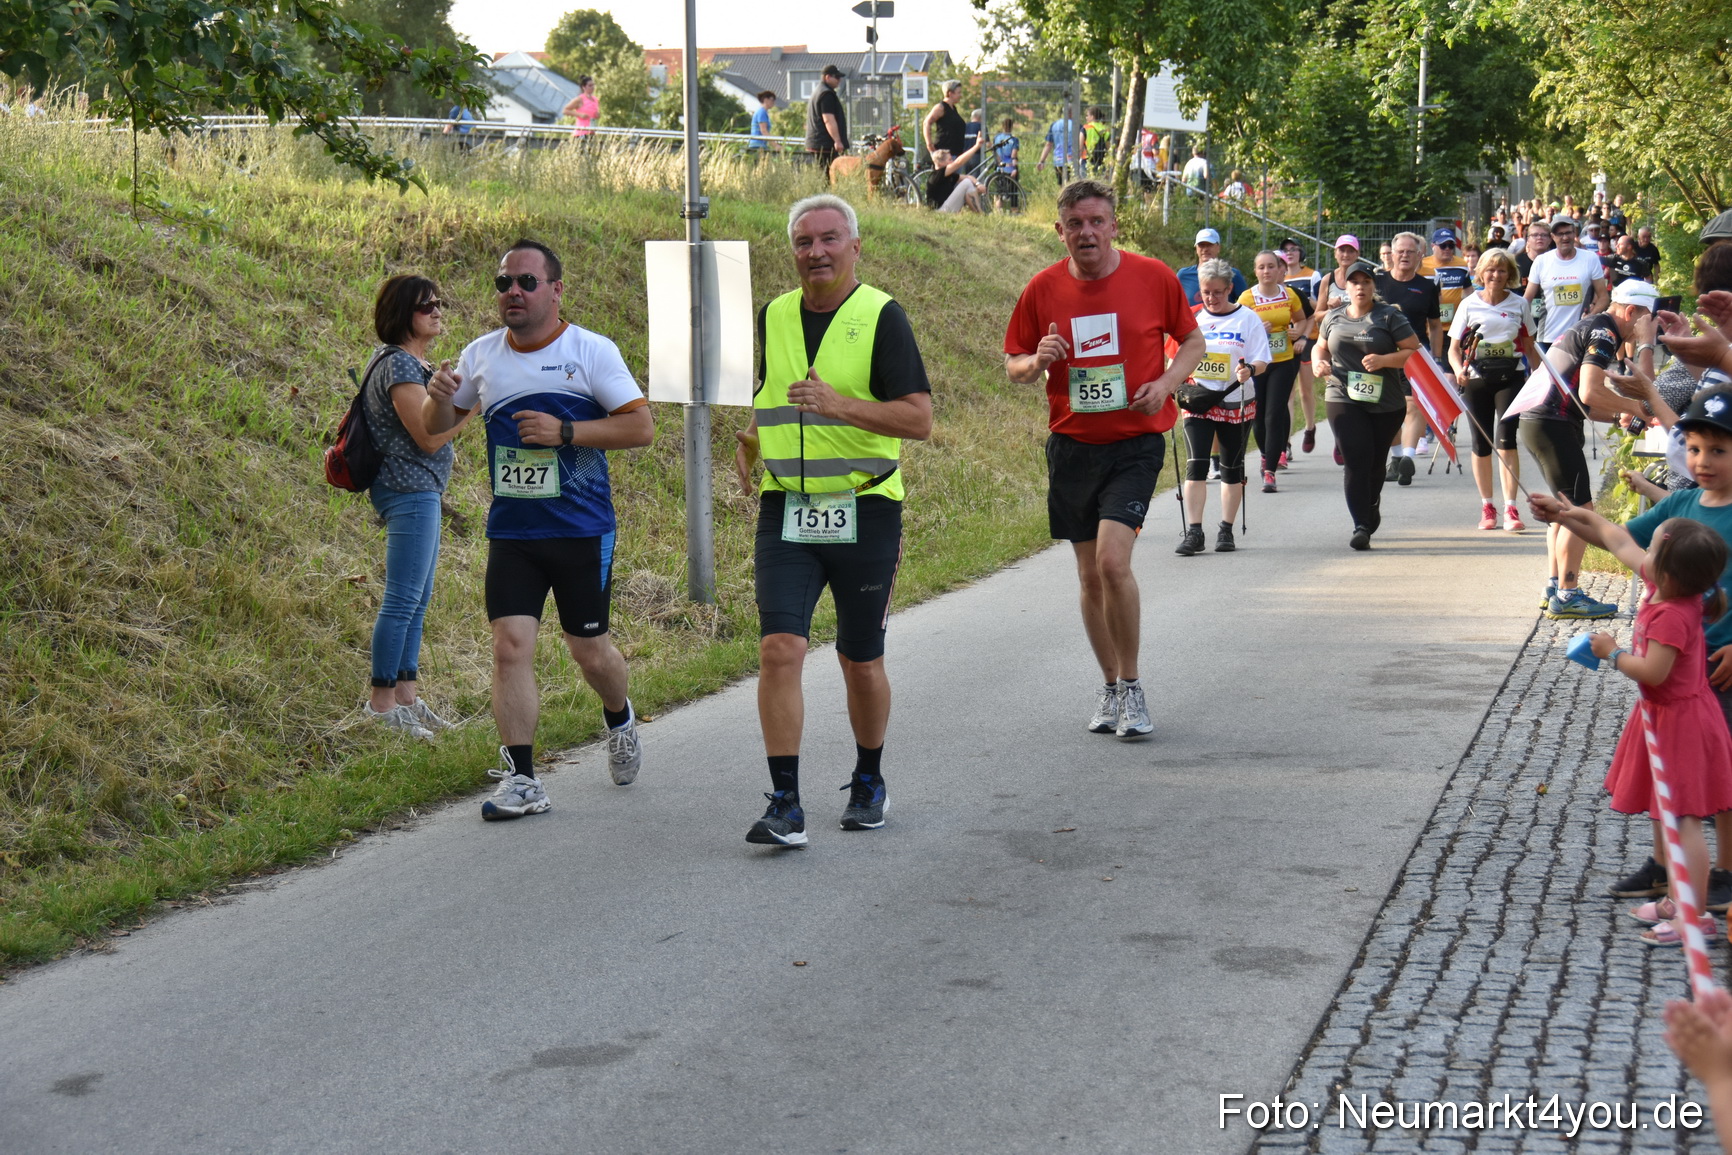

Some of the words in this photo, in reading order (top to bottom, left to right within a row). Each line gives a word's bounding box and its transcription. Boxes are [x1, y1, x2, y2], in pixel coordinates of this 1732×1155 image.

[1439, 274, 1462, 282] ischer
[1557, 291, 1579, 300] 1158
[1440, 309, 1449, 317] 48
[1484, 348, 1506, 356] 359
[1197, 362, 1225, 373] 2066
[1079, 383, 1112, 400] 555
[1353, 382, 1374, 394] 429
[501, 465, 549, 484] 2127
[794, 508, 847, 528] 1513
